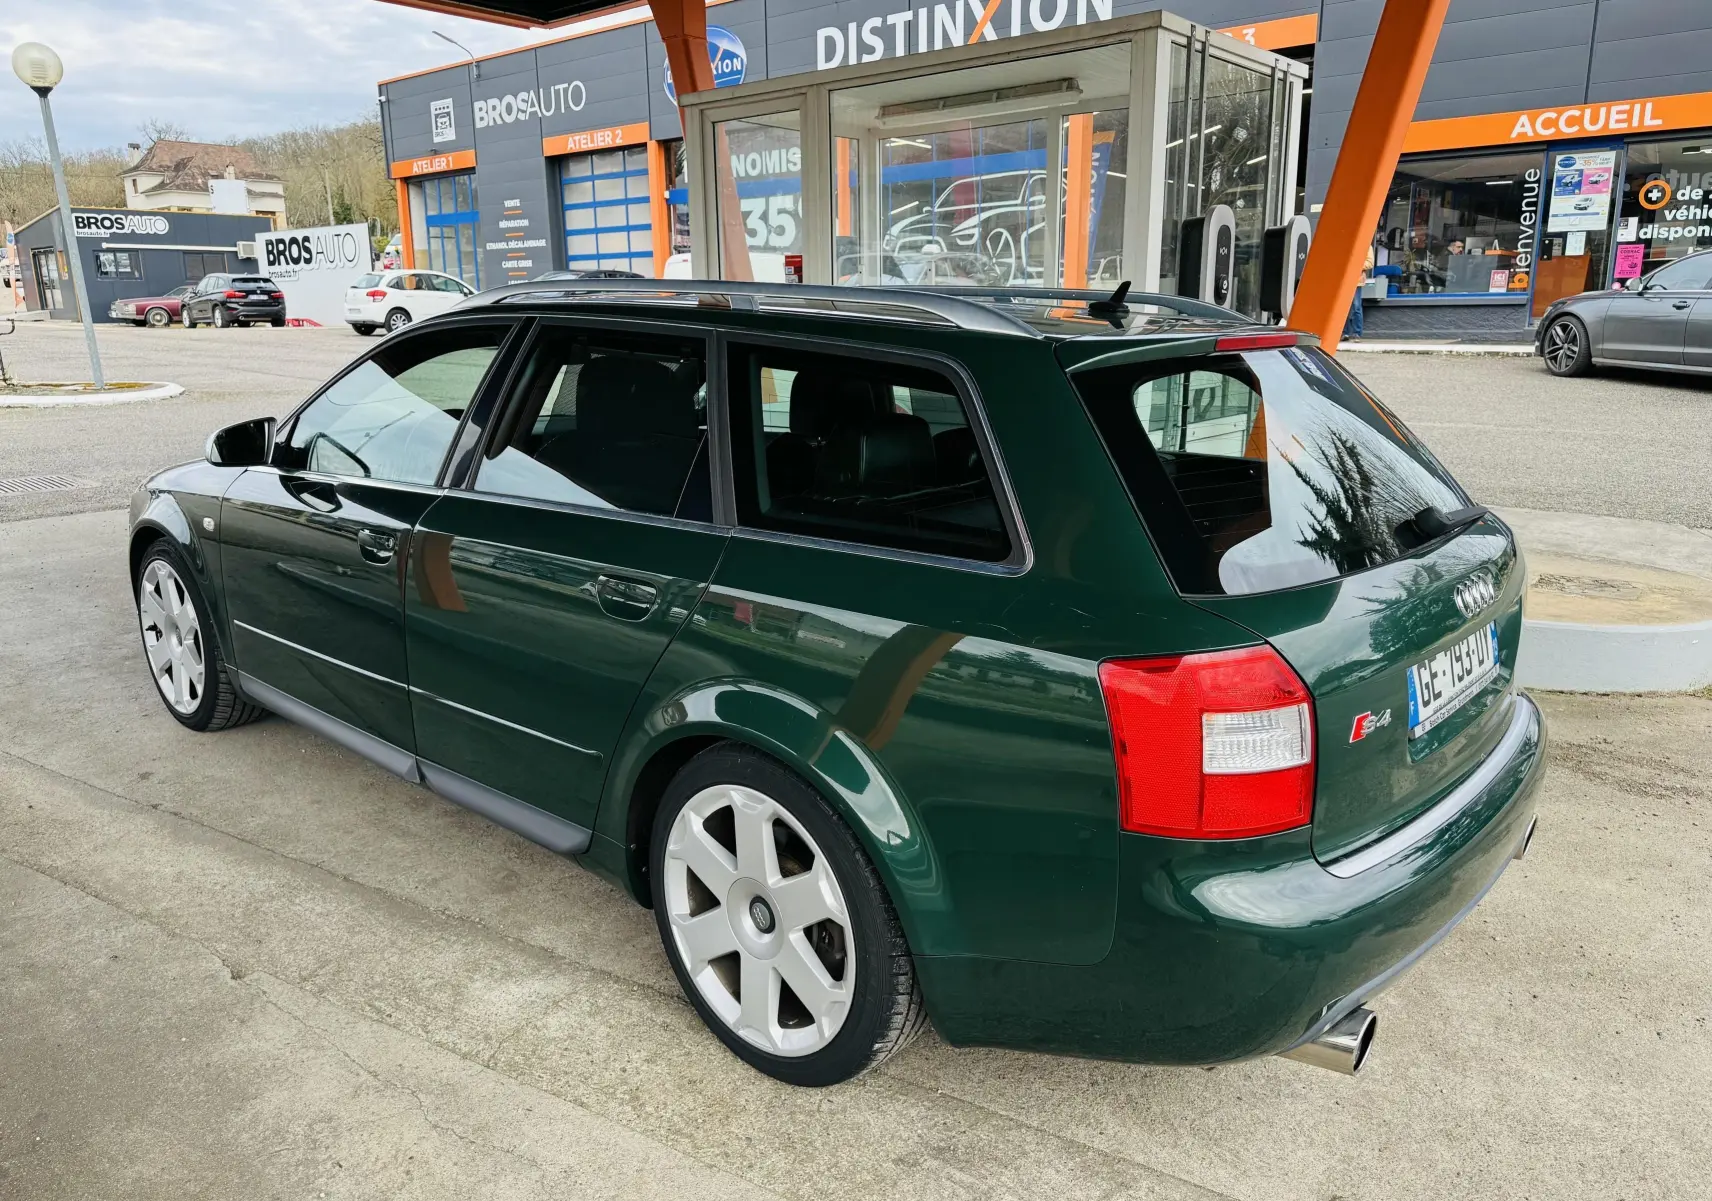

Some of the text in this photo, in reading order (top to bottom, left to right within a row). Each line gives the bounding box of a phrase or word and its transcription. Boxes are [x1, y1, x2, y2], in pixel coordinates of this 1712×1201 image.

[474, 80, 586, 129] BROSAUTO
[1510, 102, 1663, 138] ACCUEIL
[568, 129, 623, 150] ATELIER 2
[412, 156, 453, 174] ATELIER 1
[504, 199, 520, 207] VENTE
[1676, 186, 1704, 201] de
[74, 215, 167, 232] BROSAUTO
[741, 194, 803, 248] 35
[1508, 168, 1540, 289] bienvenue
[1639, 224, 1712, 241] dispon
[265, 232, 357, 266] BROSAUTO
[268, 268, 297, 279] brosauto.fr
[1361, 708, 1392, 735] S4
